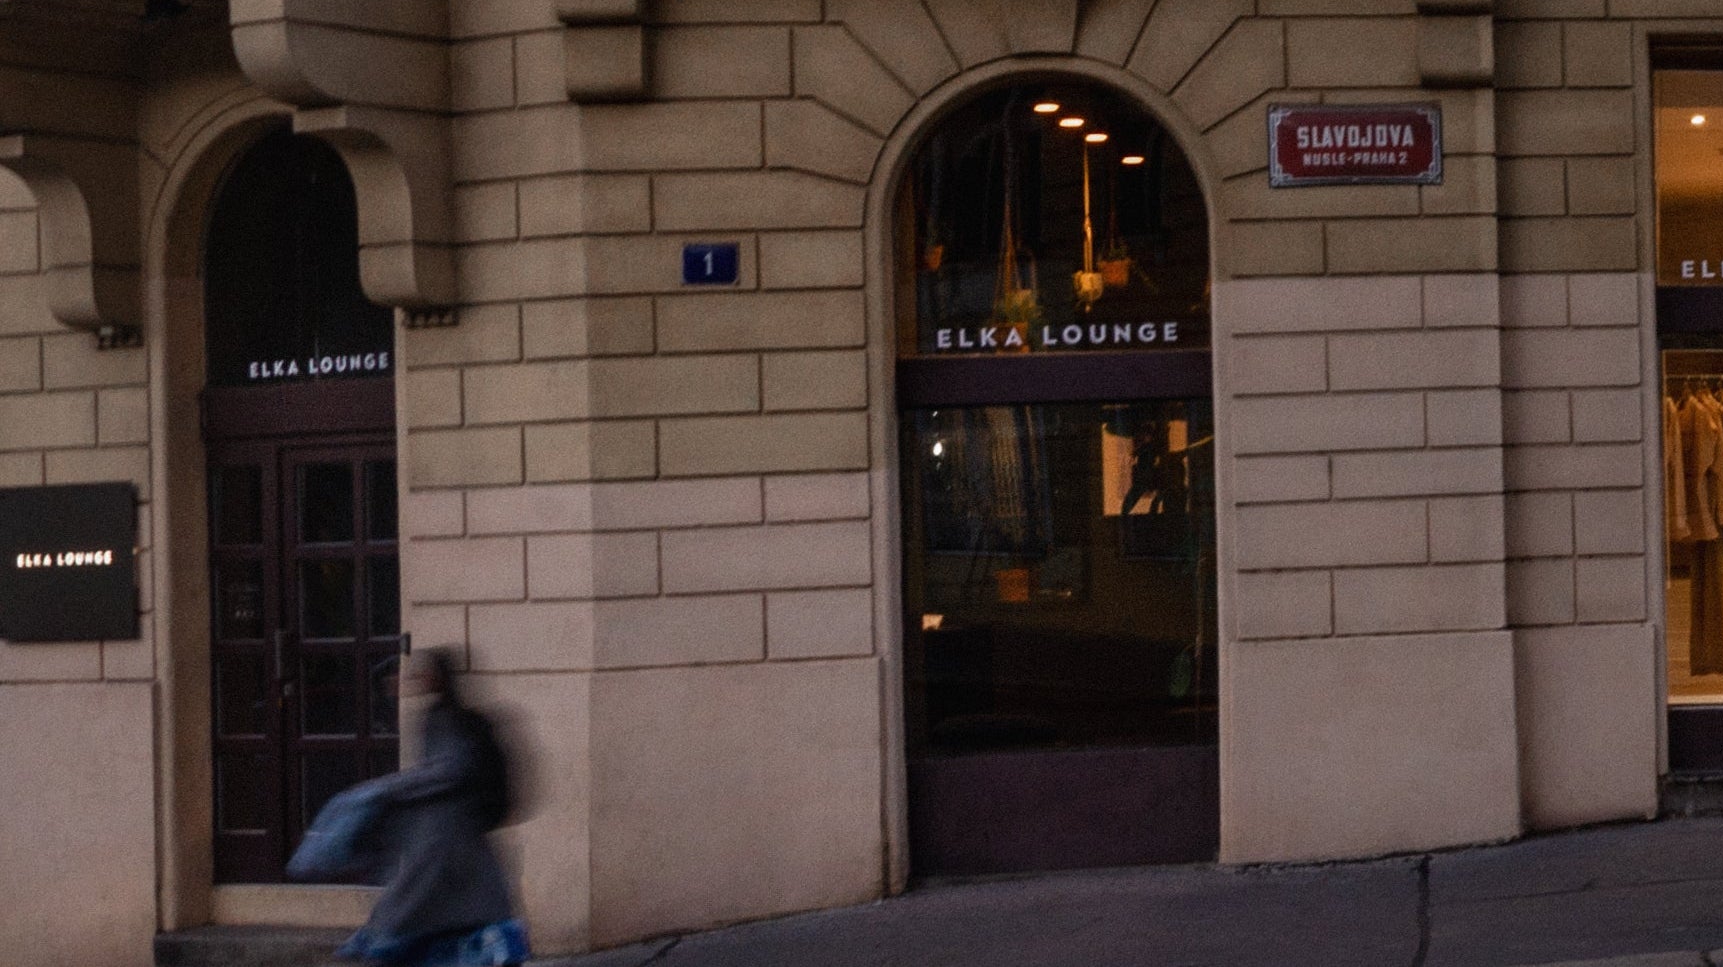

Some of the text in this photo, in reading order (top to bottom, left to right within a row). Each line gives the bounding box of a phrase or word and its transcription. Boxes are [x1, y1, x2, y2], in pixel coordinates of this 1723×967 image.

[1296, 123, 1414, 147] SLAVOJOVA
[1398, 151, 1408, 164] 2
[703, 251, 714, 276] 1
[937, 322, 1179, 349] ELKA LOUNGE
[248, 352, 390, 379] ELKA LOUNGE
[16, 550, 113, 568] ELKA LOUNGE
